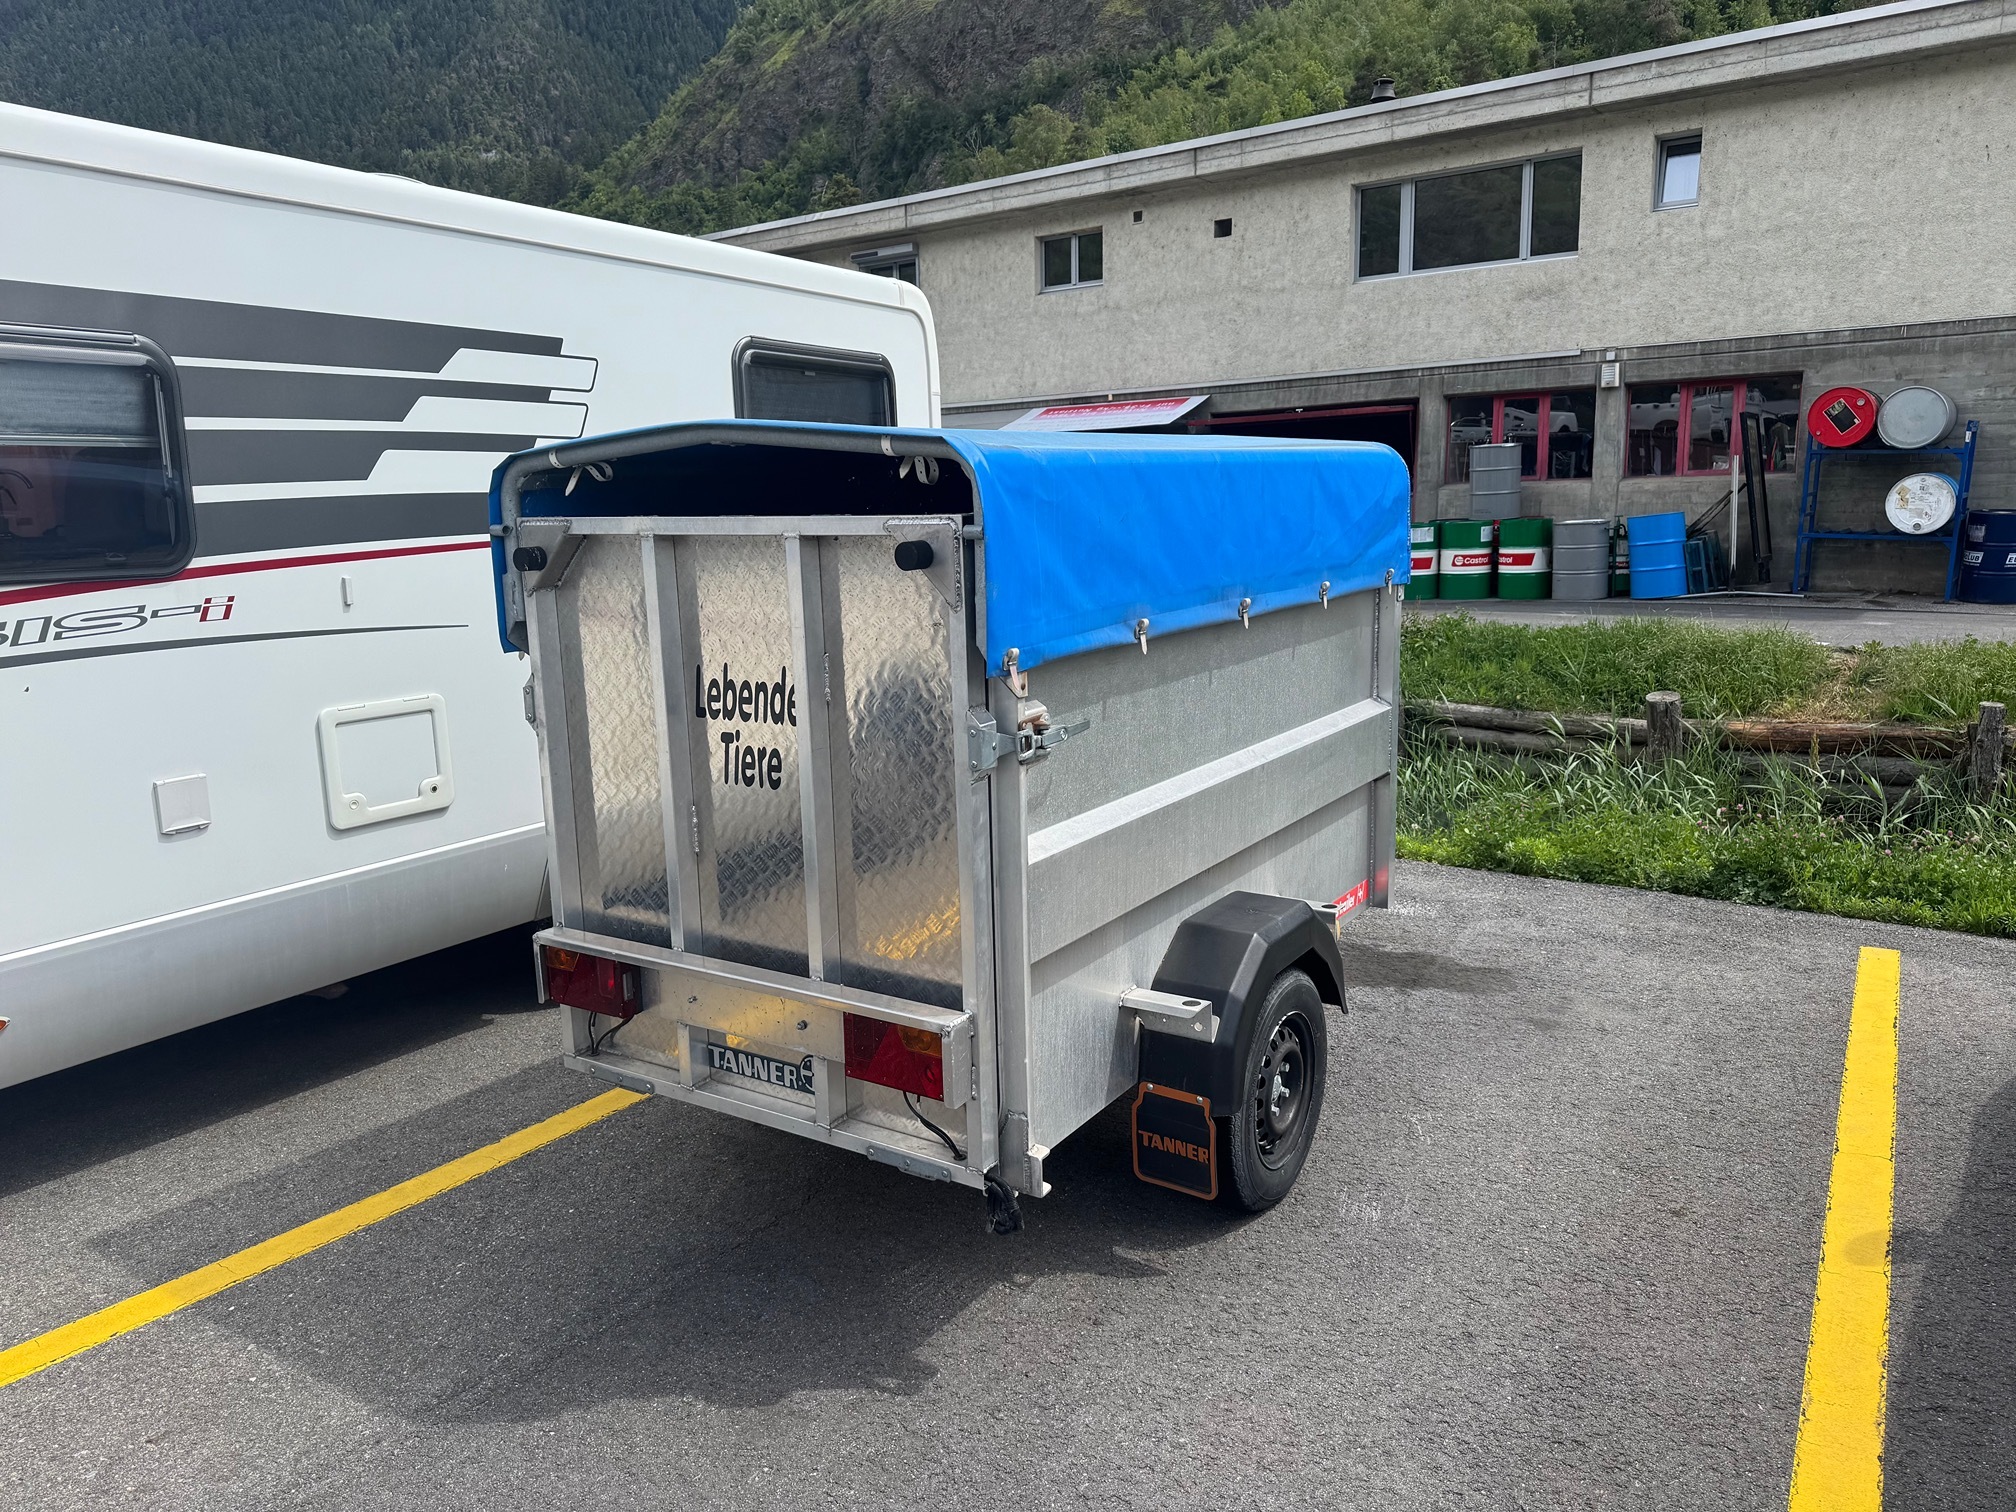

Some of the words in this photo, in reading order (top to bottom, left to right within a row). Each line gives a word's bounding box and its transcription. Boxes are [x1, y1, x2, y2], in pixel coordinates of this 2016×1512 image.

[1464, 556, 1489, 564] Castrol
[0, 596, 235, 647] IS-i
[695, 662, 797, 727] Lebende
[720, 729, 783, 790] Tiere
[707, 1045, 798, 1089] TANNER
[1138, 1129, 1209, 1164] TANNER
